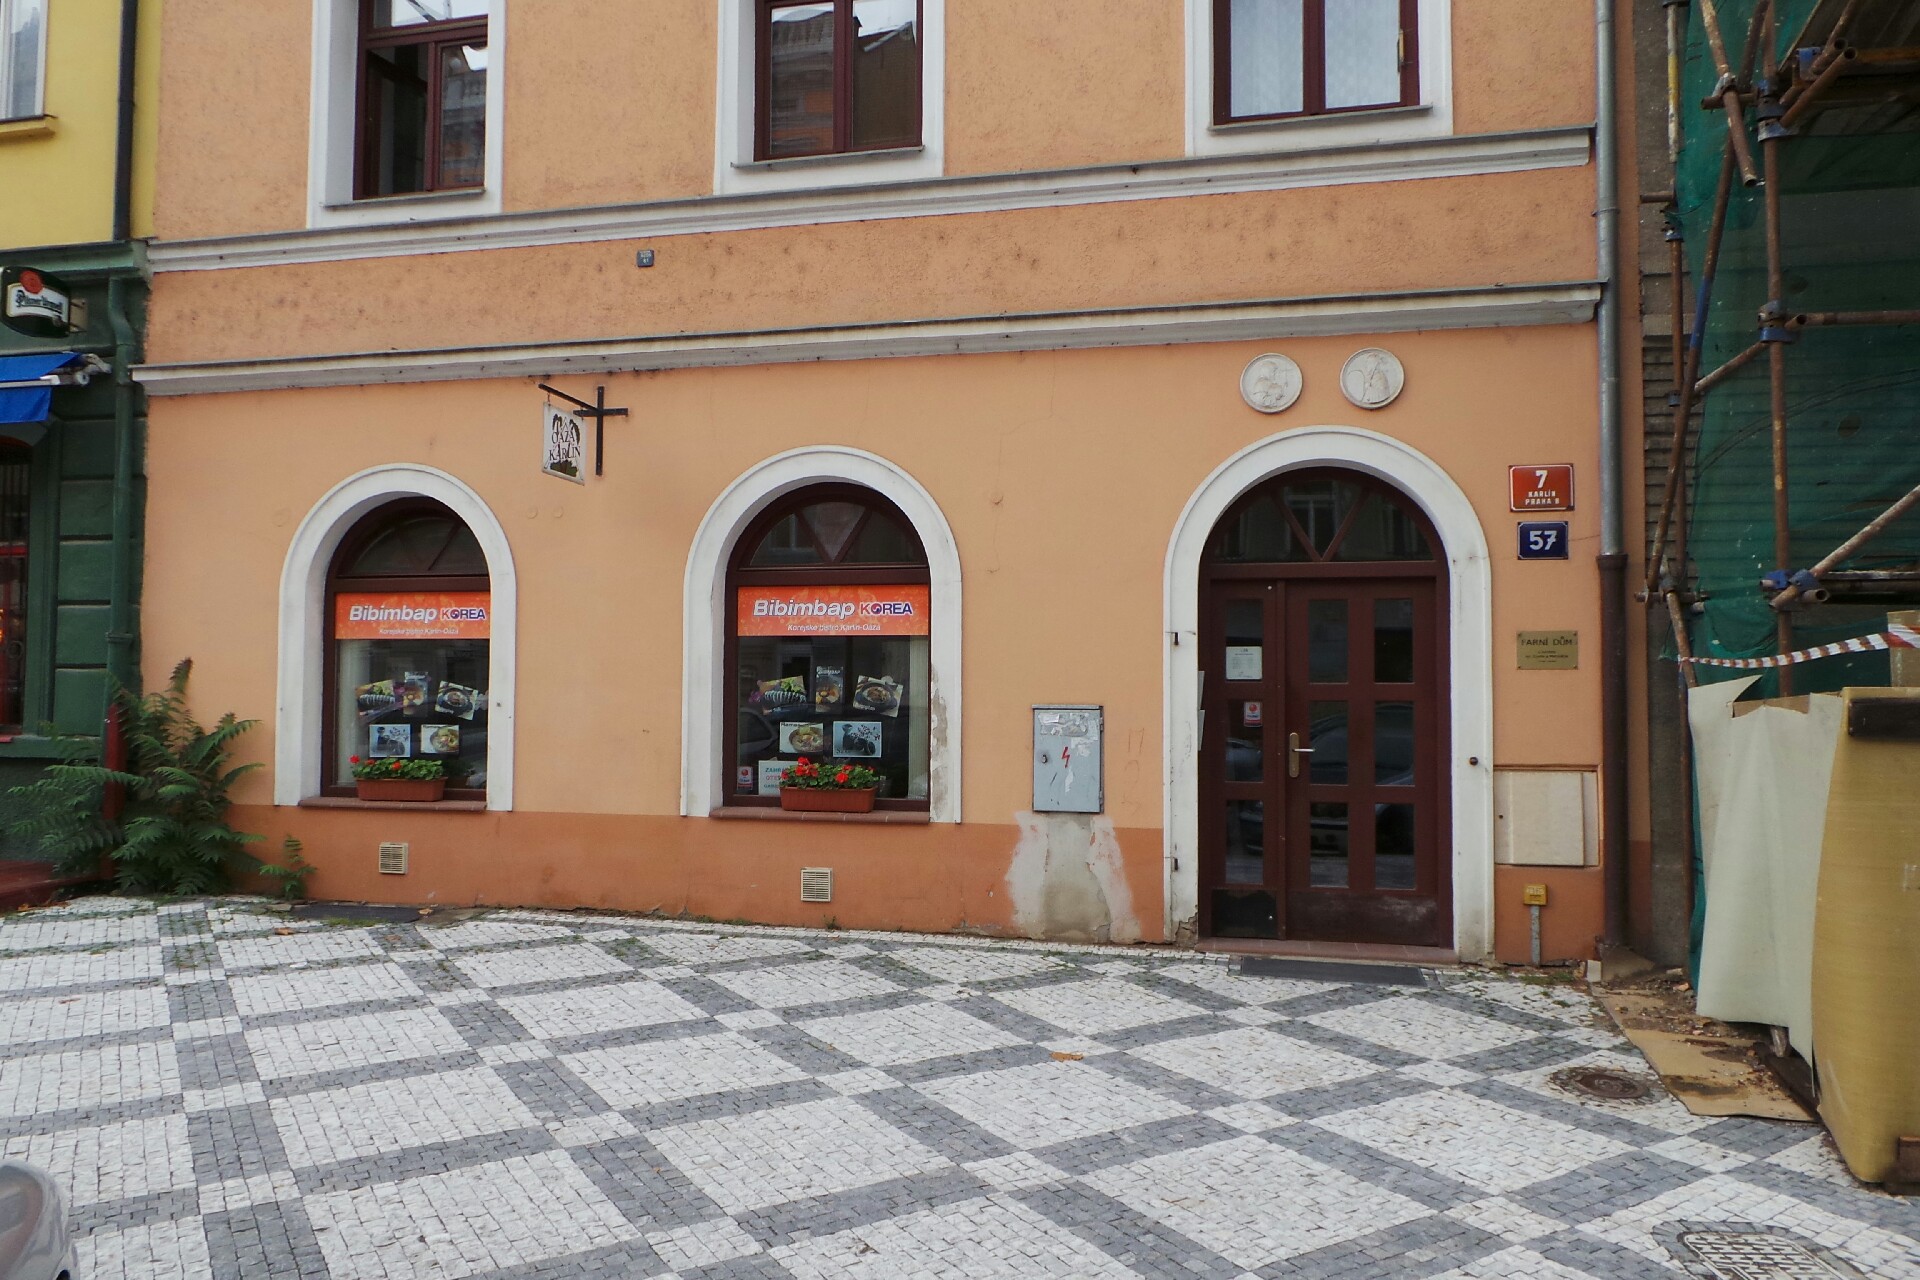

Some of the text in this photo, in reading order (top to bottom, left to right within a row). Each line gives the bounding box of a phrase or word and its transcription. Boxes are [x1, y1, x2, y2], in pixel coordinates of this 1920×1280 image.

[1535, 470, 1548, 488] 7
[1525, 498, 1552, 506] PRAHA
[1529, 530, 1557, 551] 57
[350, 605, 486, 624] Bibimbap KOREA
[753, 599, 913, 619] Bibimbap KOREA
